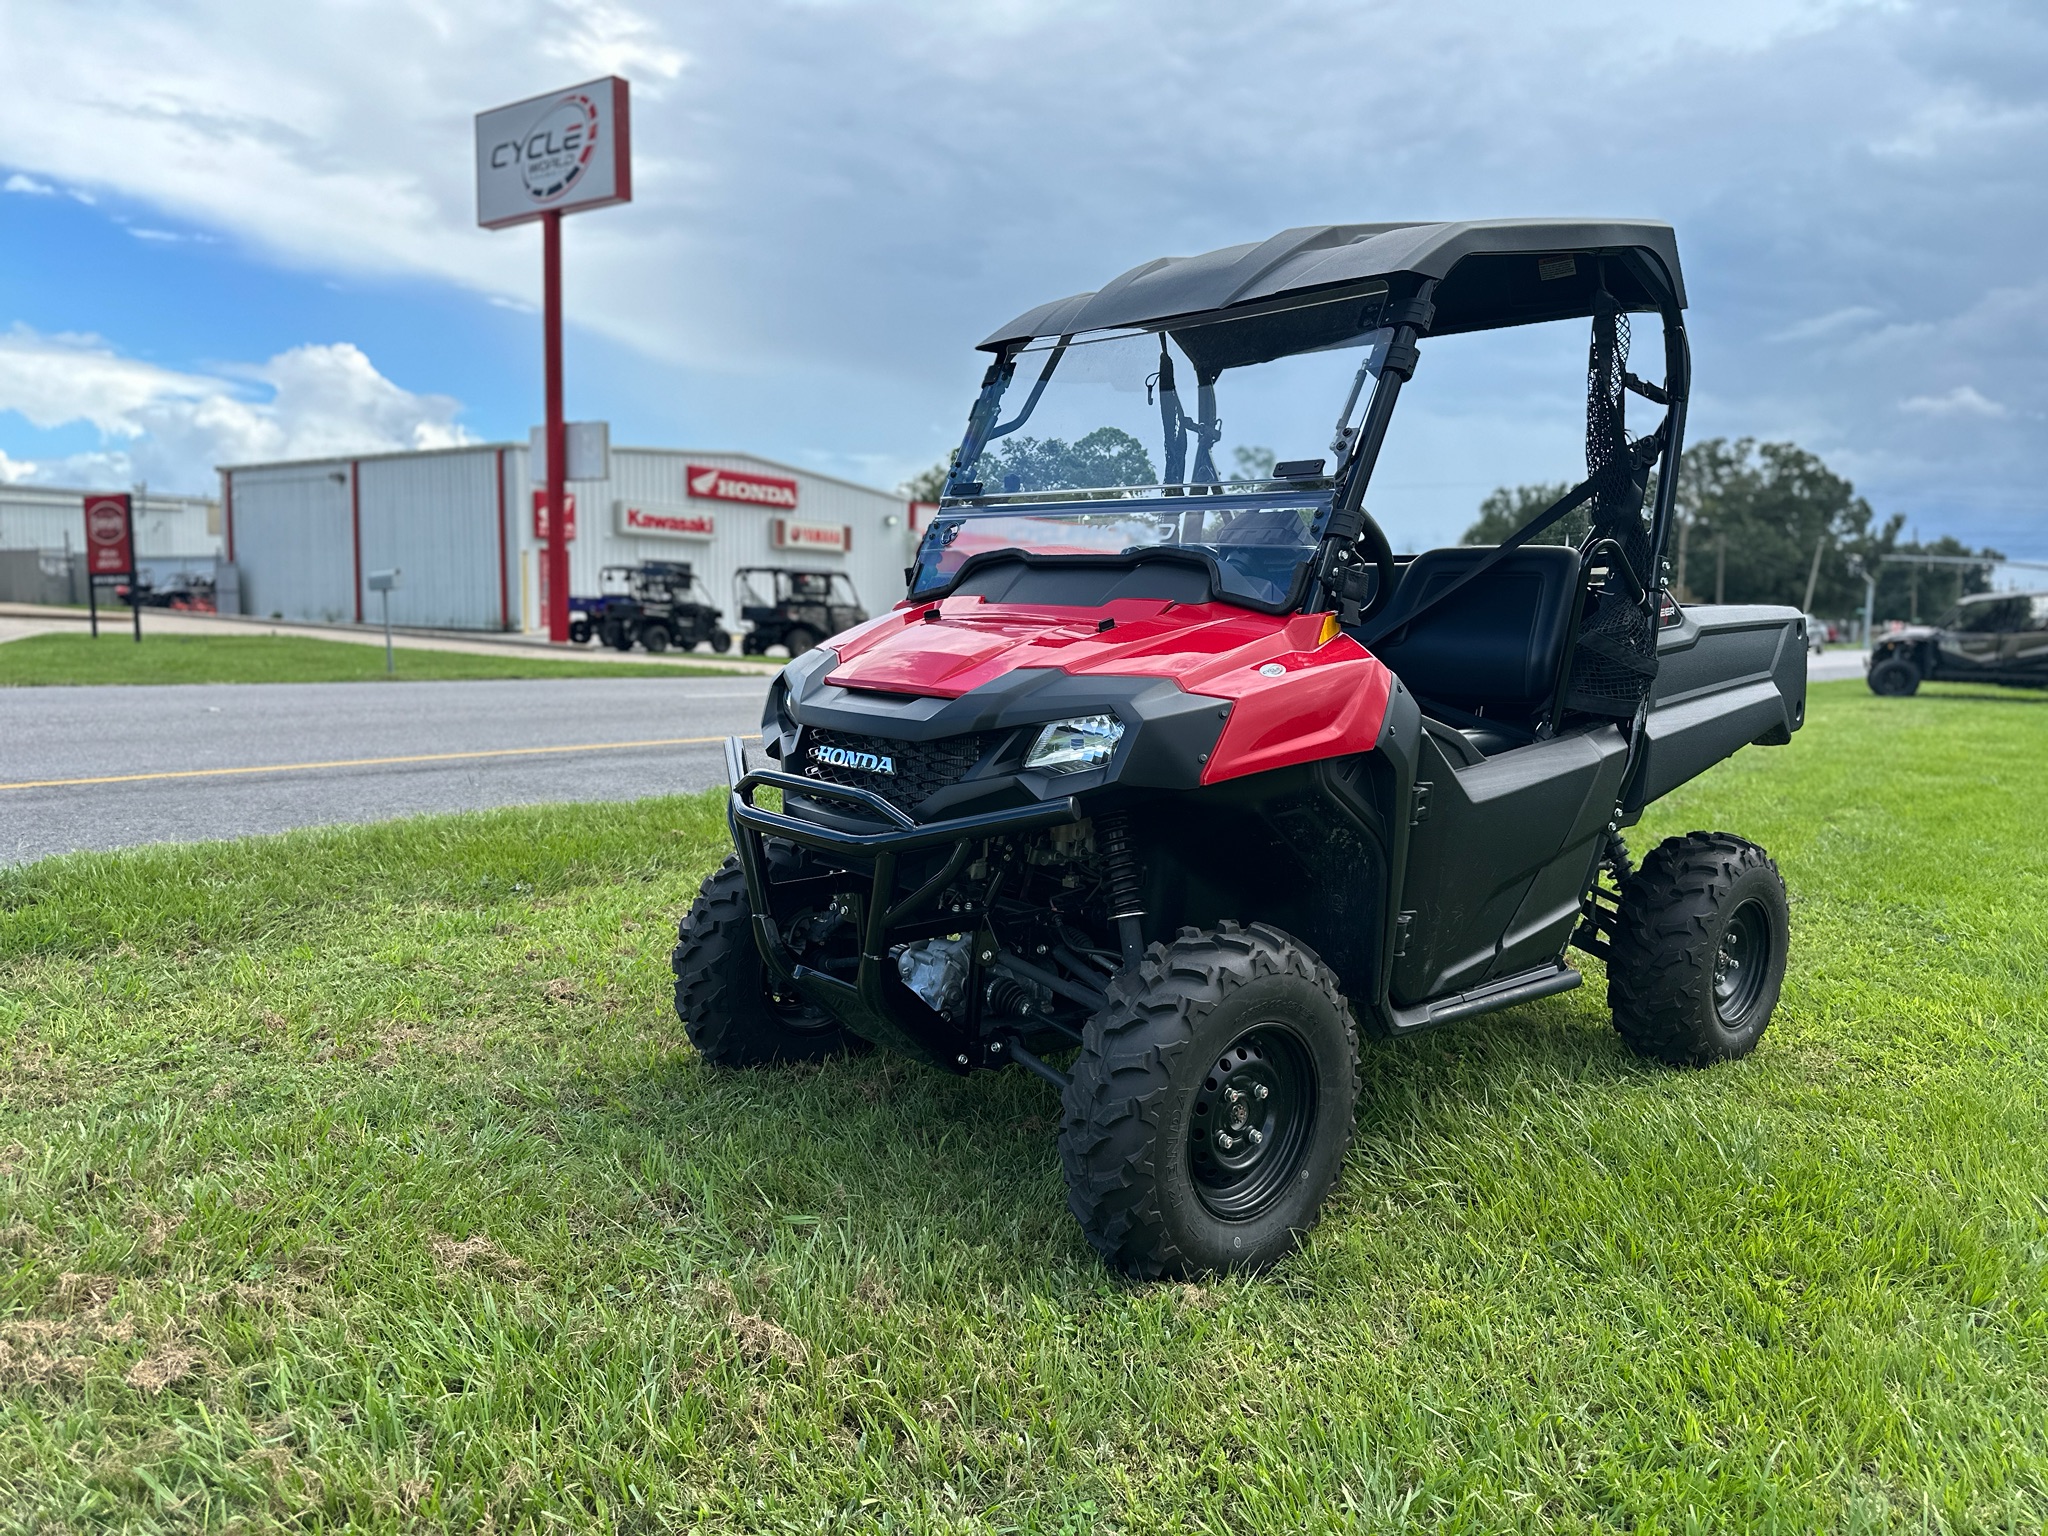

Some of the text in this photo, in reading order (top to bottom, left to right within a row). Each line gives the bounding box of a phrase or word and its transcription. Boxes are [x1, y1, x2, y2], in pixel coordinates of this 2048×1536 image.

[491, 123, 583, 170] CYCLE
[717, 479, 795, 505] HONDA
[627, 509, 714, 534] Kawasaki
[816, 745, 895, 776] HONDA
[1165, 1088, 1189, 1209] KENDA
